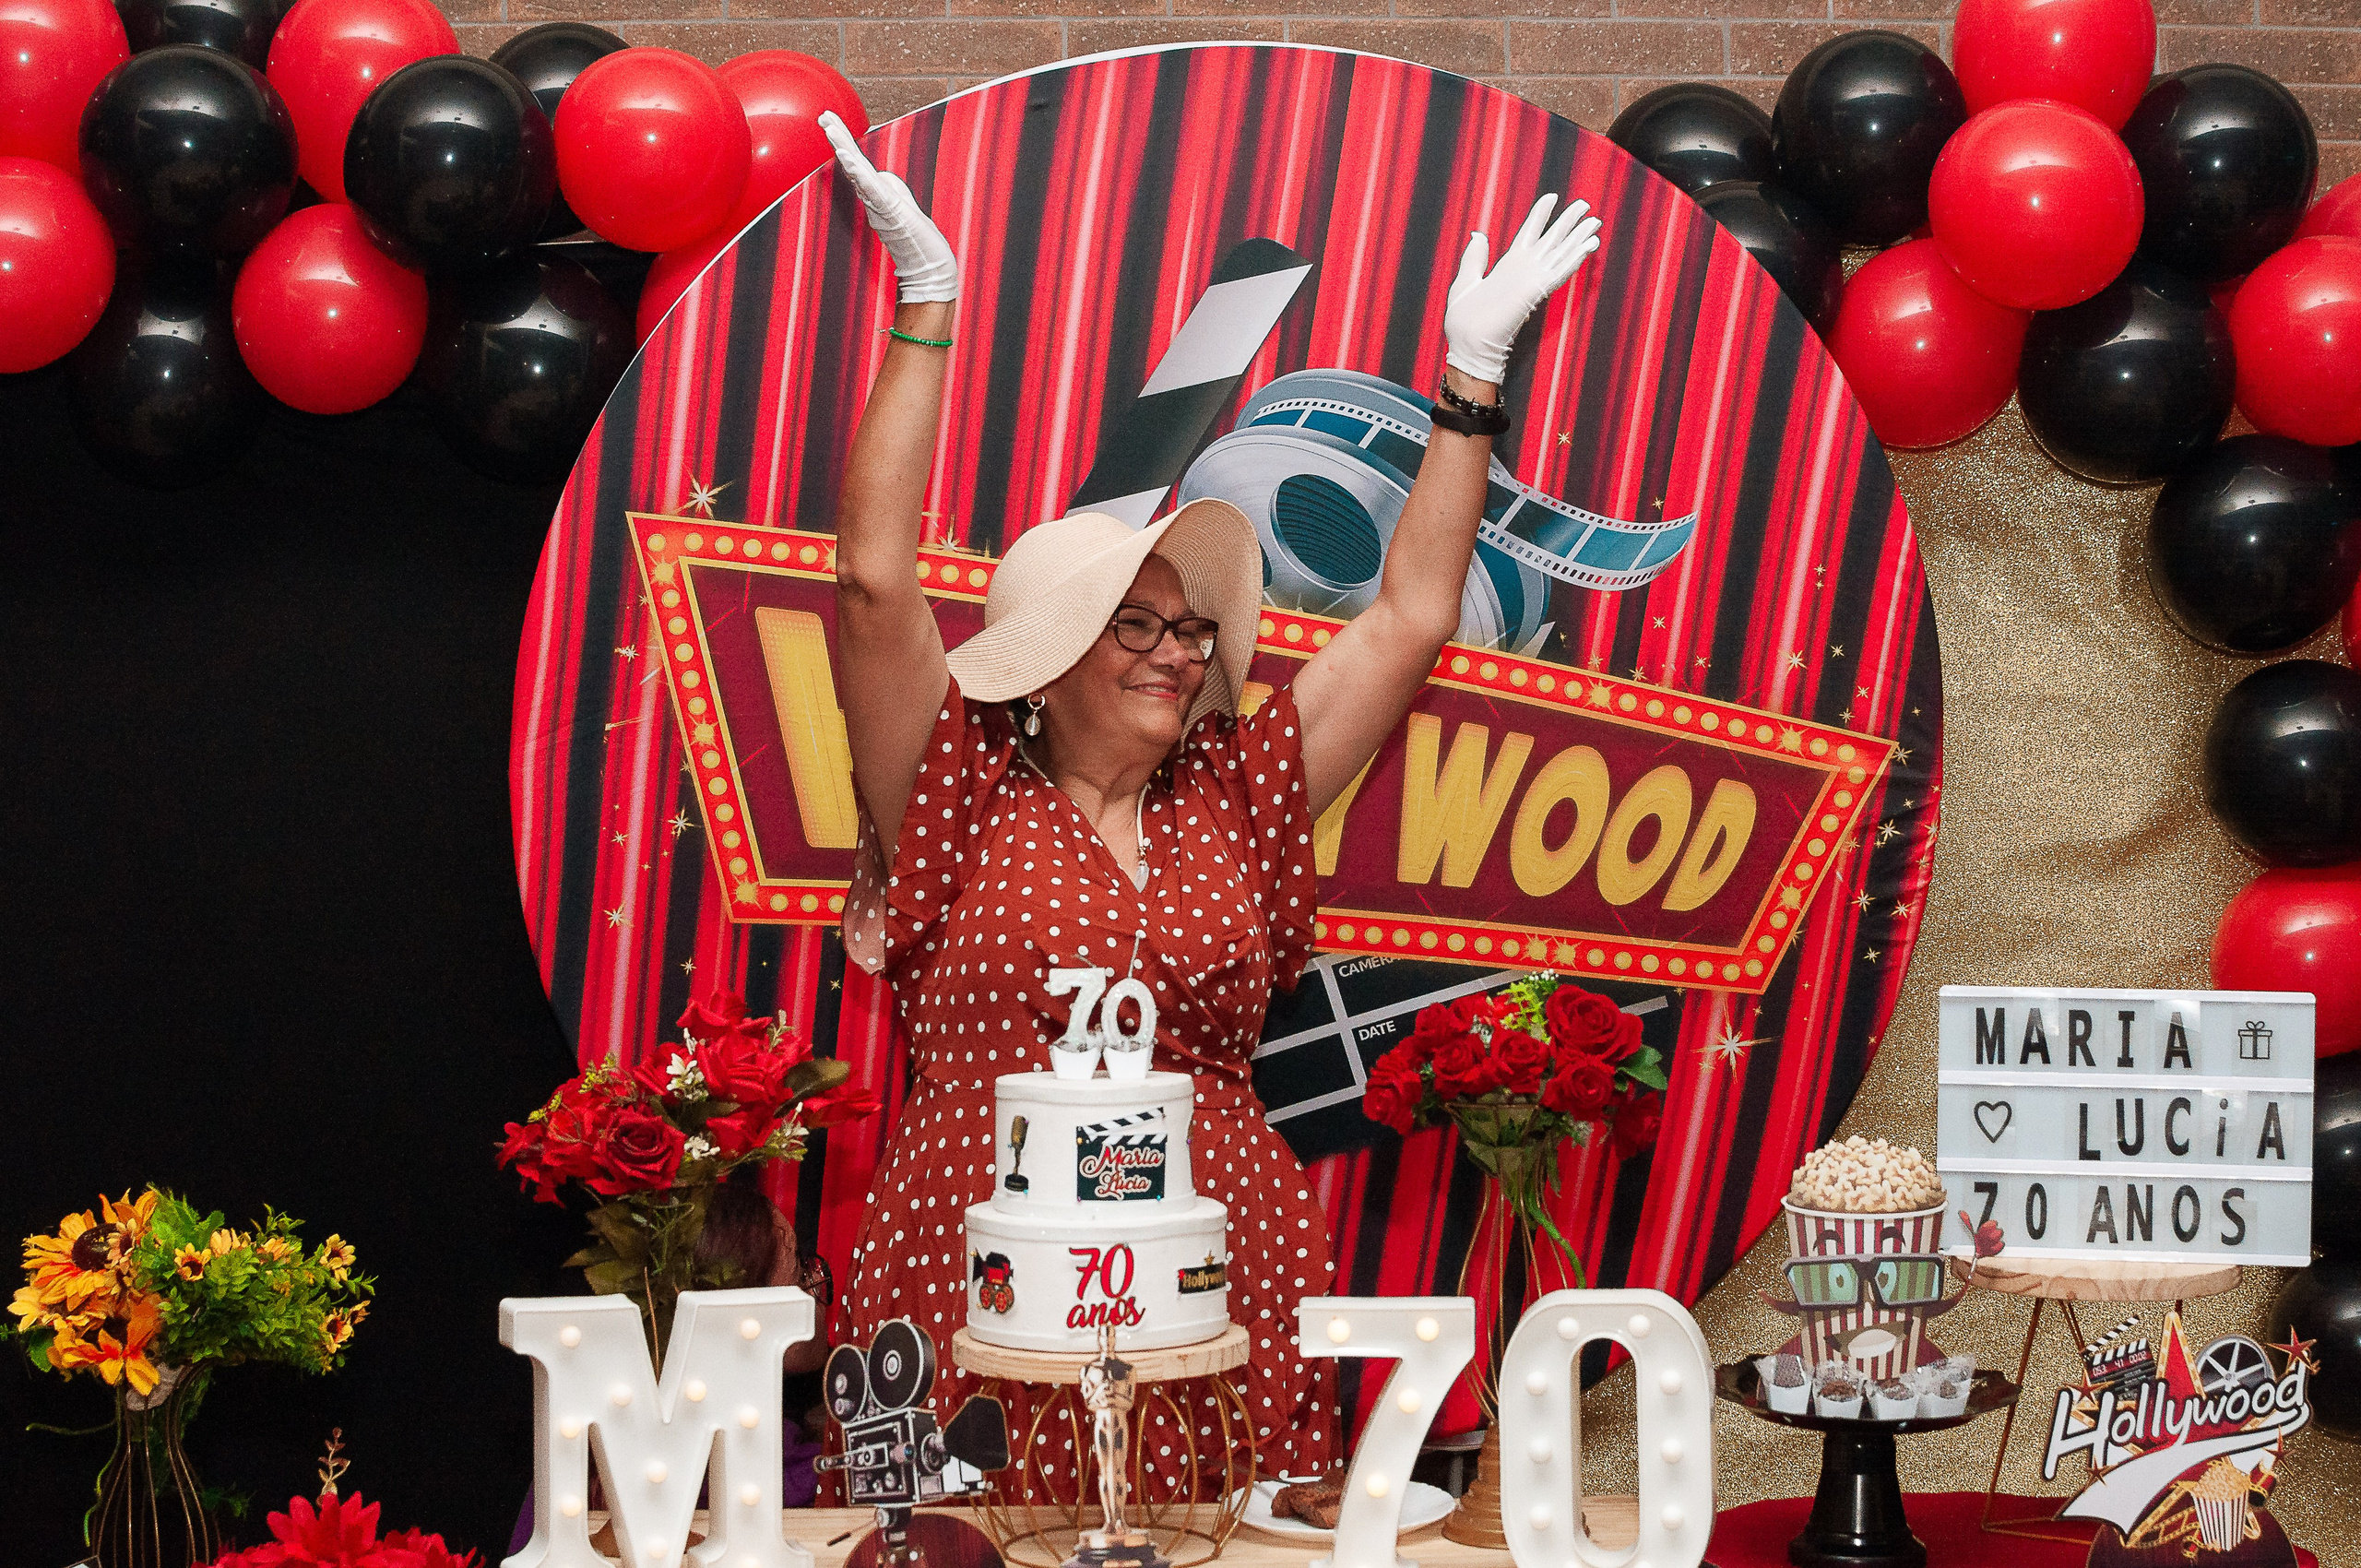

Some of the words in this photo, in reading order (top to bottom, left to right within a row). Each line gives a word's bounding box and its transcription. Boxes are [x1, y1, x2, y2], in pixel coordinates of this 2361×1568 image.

[1338, 956, 1402, 977] CAMER
[1048, 967, 1157, 1051] 70
[1358, 1020, 1396, 1040] DATE
[1975, 1006, 2193, 1069] MARIA
[1079, 1144, 1166, 1178] Maria
[2085, 1183, 2246, 1246] ANOS
[1068, 1242, 1134, 1300] 70
[1066, 1296, 1146, 1329] anos
[499, 1285, 815, 1568] M
[1299, 1288, 1716, 1568] 70
[2043, 1350, 2308, 1481] Hollywood
